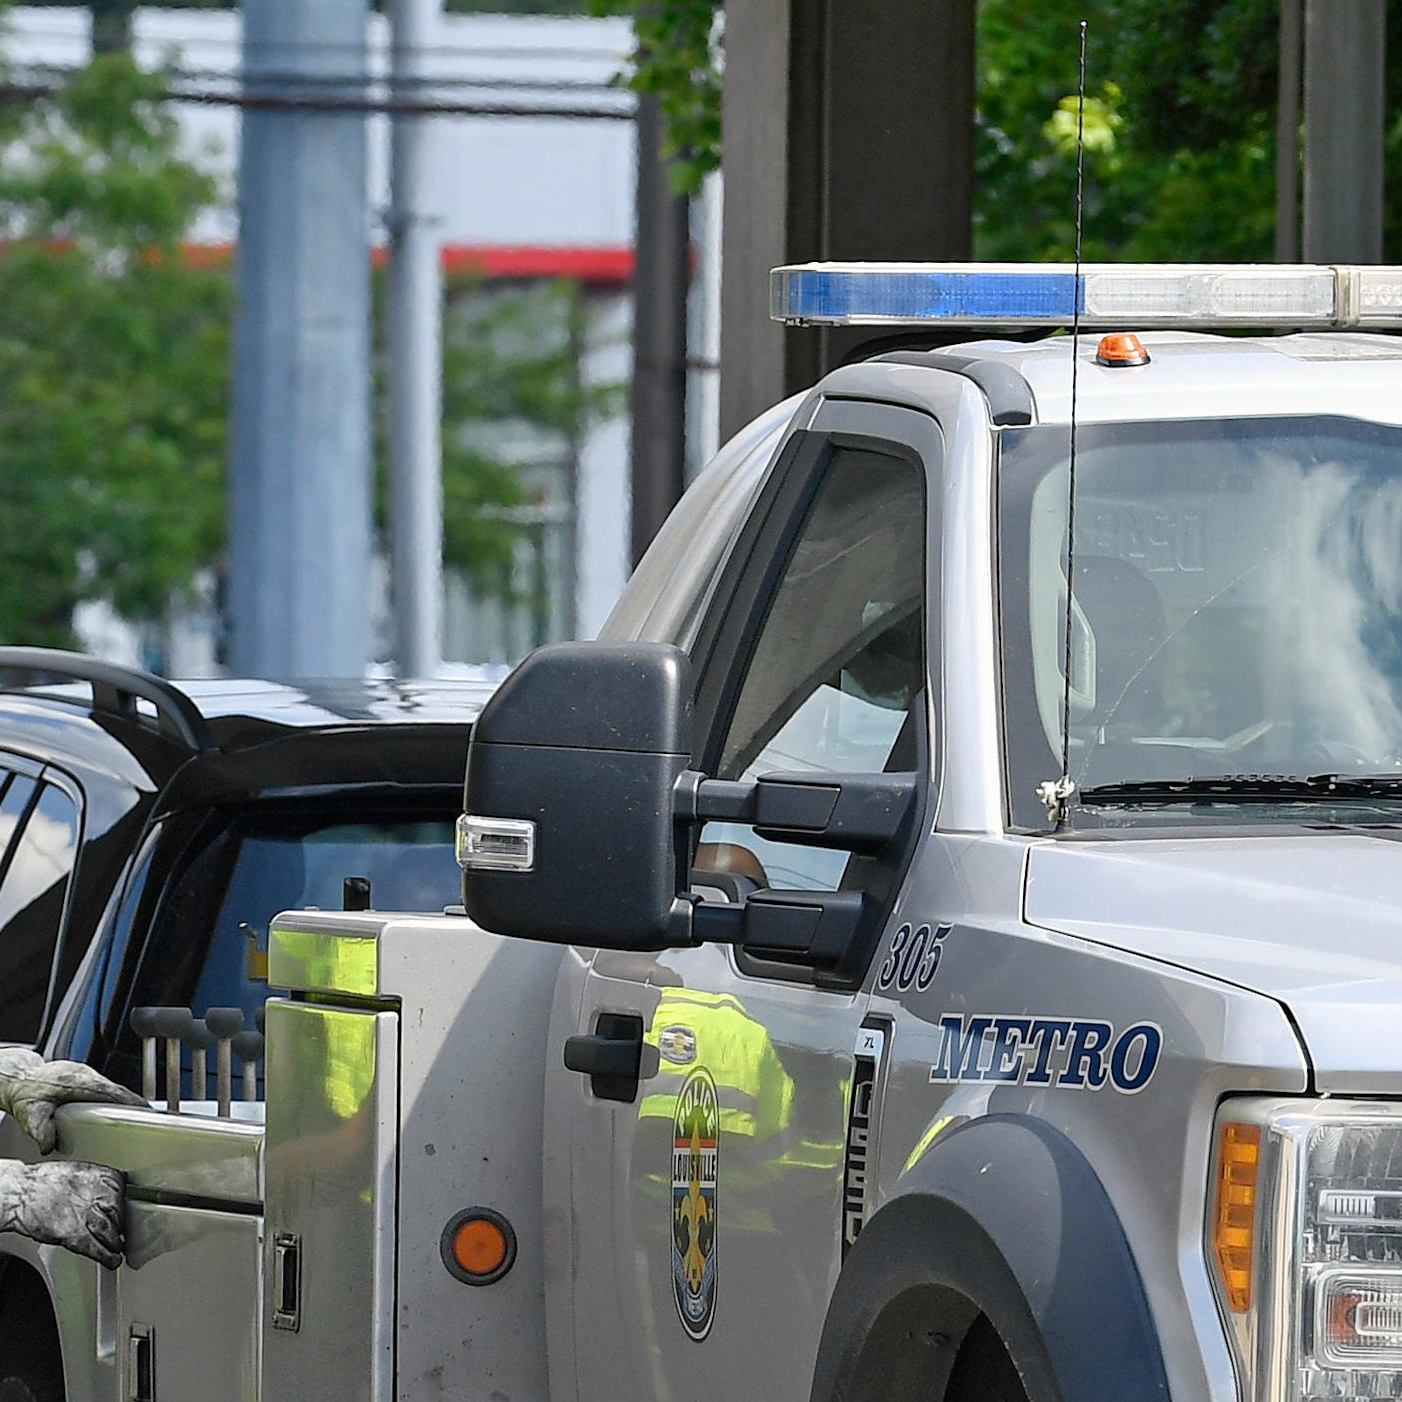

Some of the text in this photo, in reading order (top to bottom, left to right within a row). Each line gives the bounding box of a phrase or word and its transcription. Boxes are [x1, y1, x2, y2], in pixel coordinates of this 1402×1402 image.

[878, 921, 955, 992] 305
[863, 1035, 875, 1050] XL
[929, 1013, 1163, 1095] METRO
[678, 1080, 716, 1138] POLICE
[673, 1153, 717, 1182] LOUISVILLE
